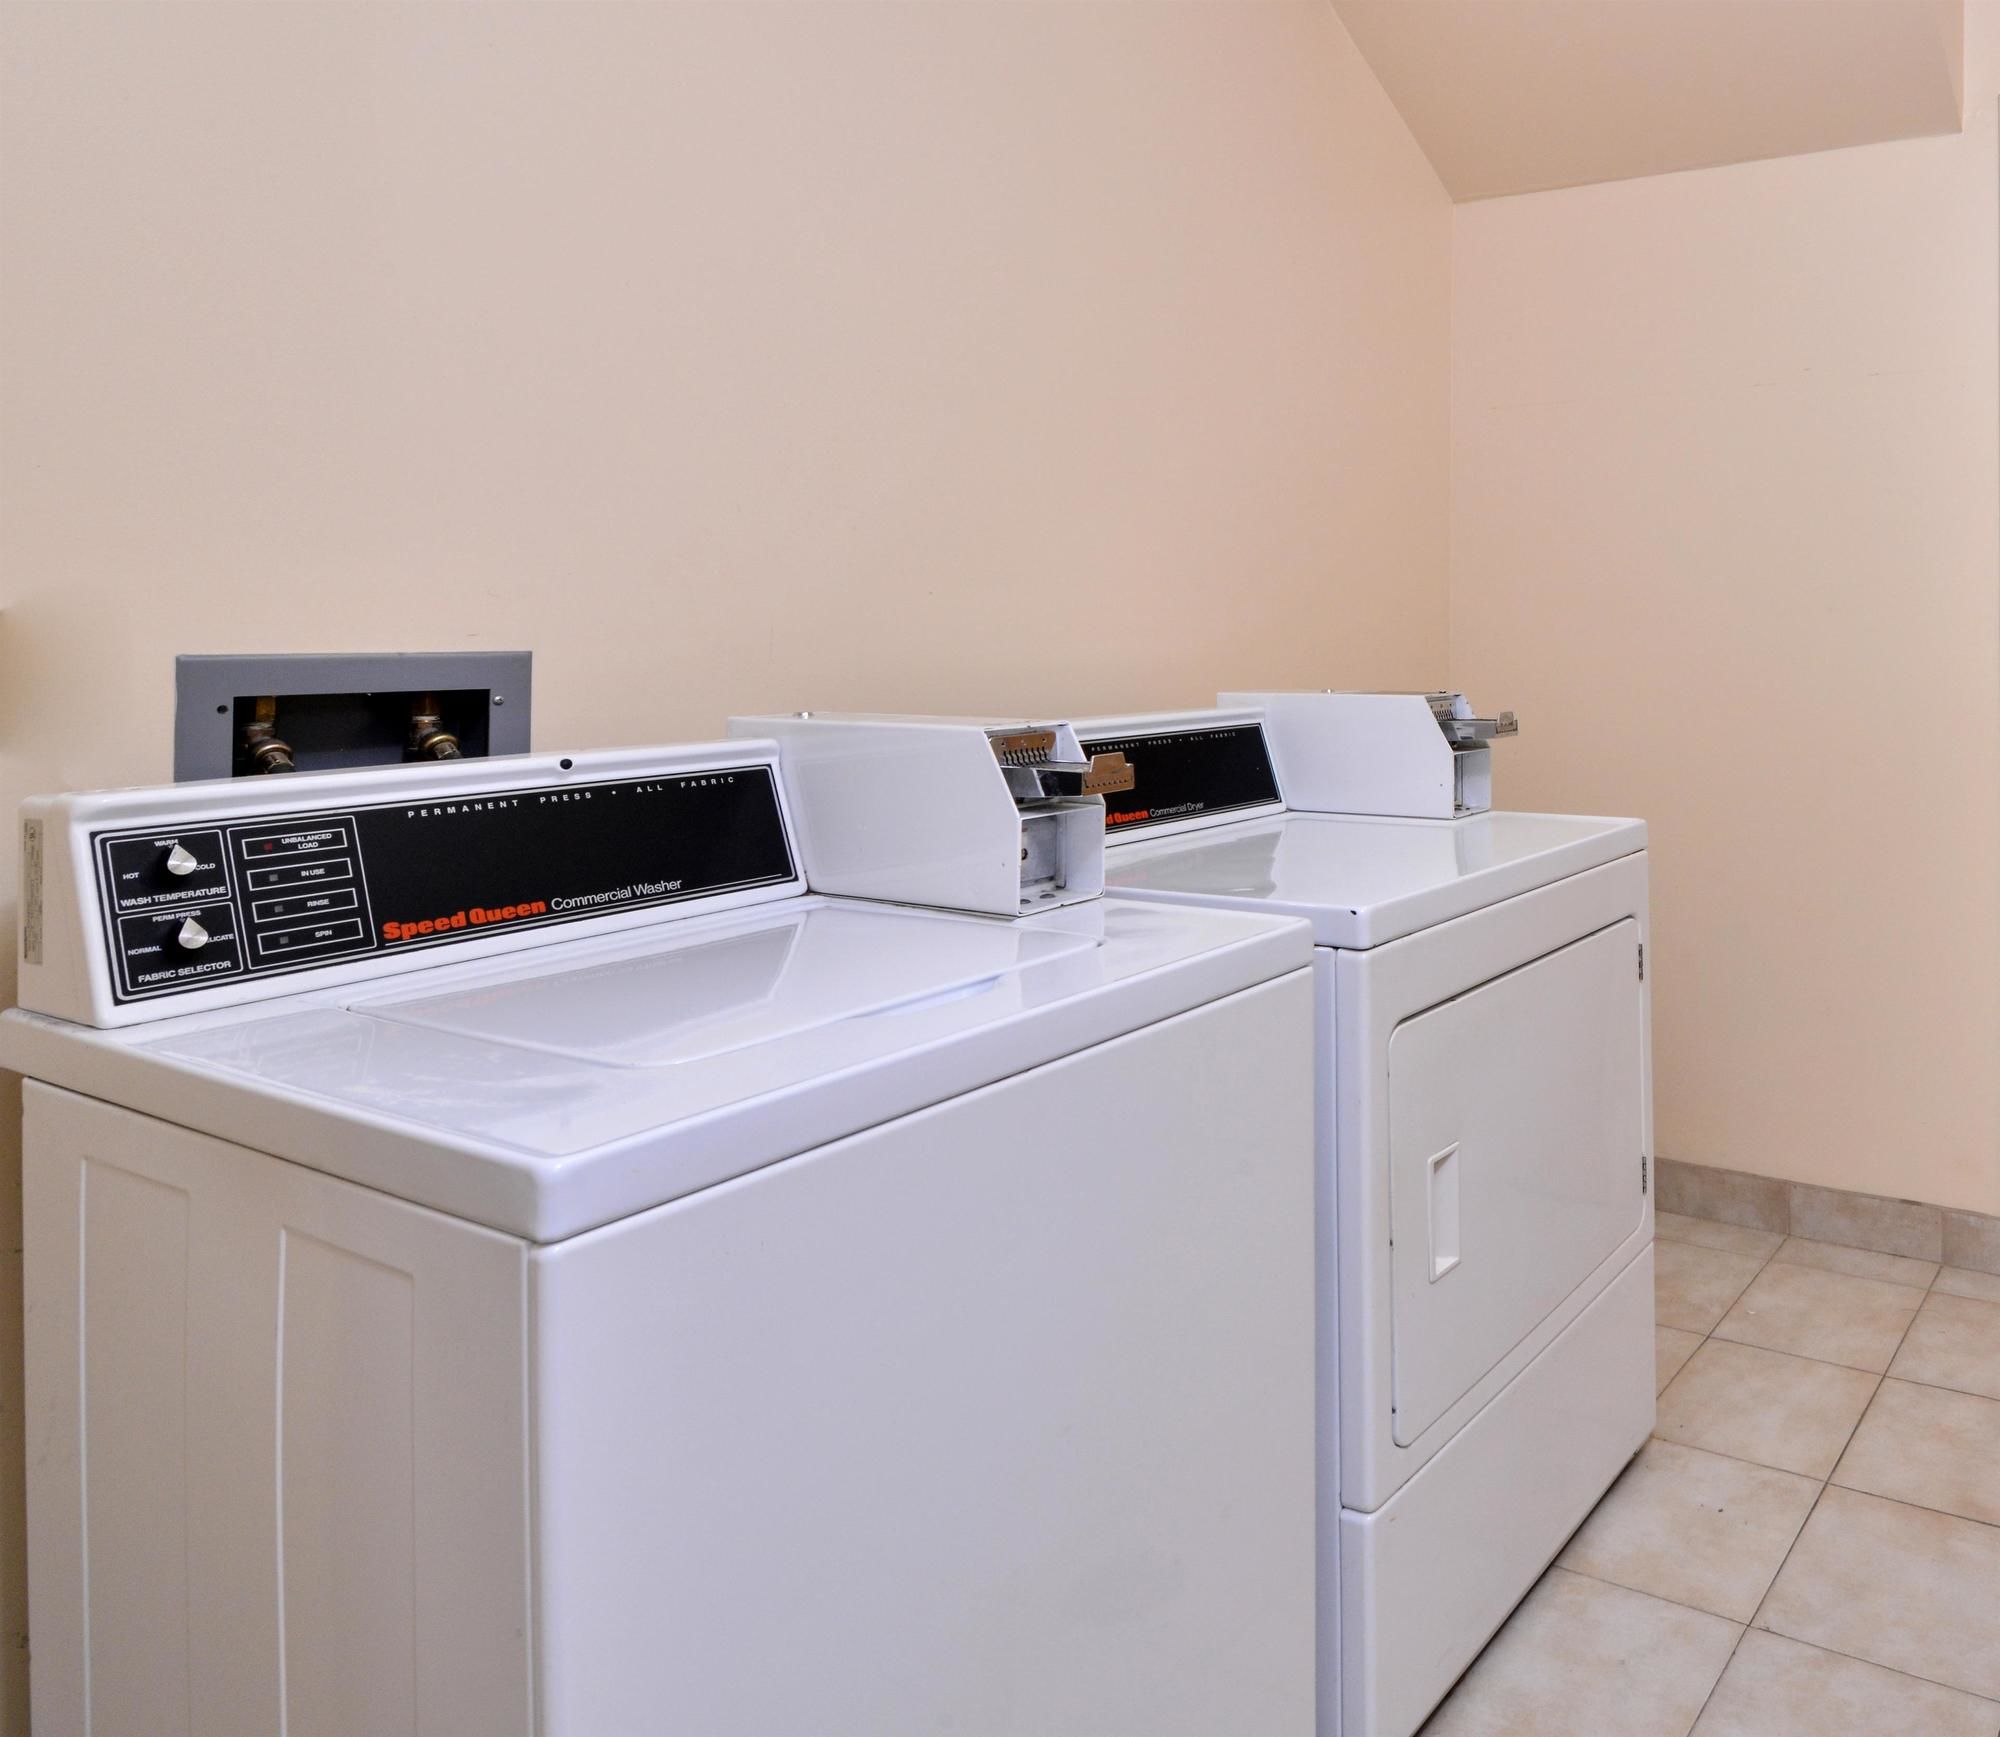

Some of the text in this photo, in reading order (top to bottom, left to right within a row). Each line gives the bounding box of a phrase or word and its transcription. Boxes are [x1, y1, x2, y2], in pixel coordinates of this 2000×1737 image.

[407, 775, 736, 819] PERMANENT PRESS ALL FABRIC
[1114, 809, 1149, 824] Queen
[1150, 802, 1187, 817] Commercial
[1187, 801, 1205, 812] Dryer
[154, 839, 179, 847] WARM
[281, 832, 332, 845] UNBALANCED
[297, 841, 319, 849] LOAD
[122, 872, 140, 880] HOT
[301, 867, 326, 877] IN USE
[120, 886, 228, 907] WASH TEMPERATURE
[306, 898, 330, 908] RINSE
[383, 878, 683, 941] Speed Queen Commercial Washer
[152, 909, 202, 923] PERM PRESS
[206, 933, 235, 943] LICATE
[314, 928, 333, 939] SPIN
[127, 945, 163, 956] NORMAL
[137, 960, 232, 983] FABRIC SELECTOR
